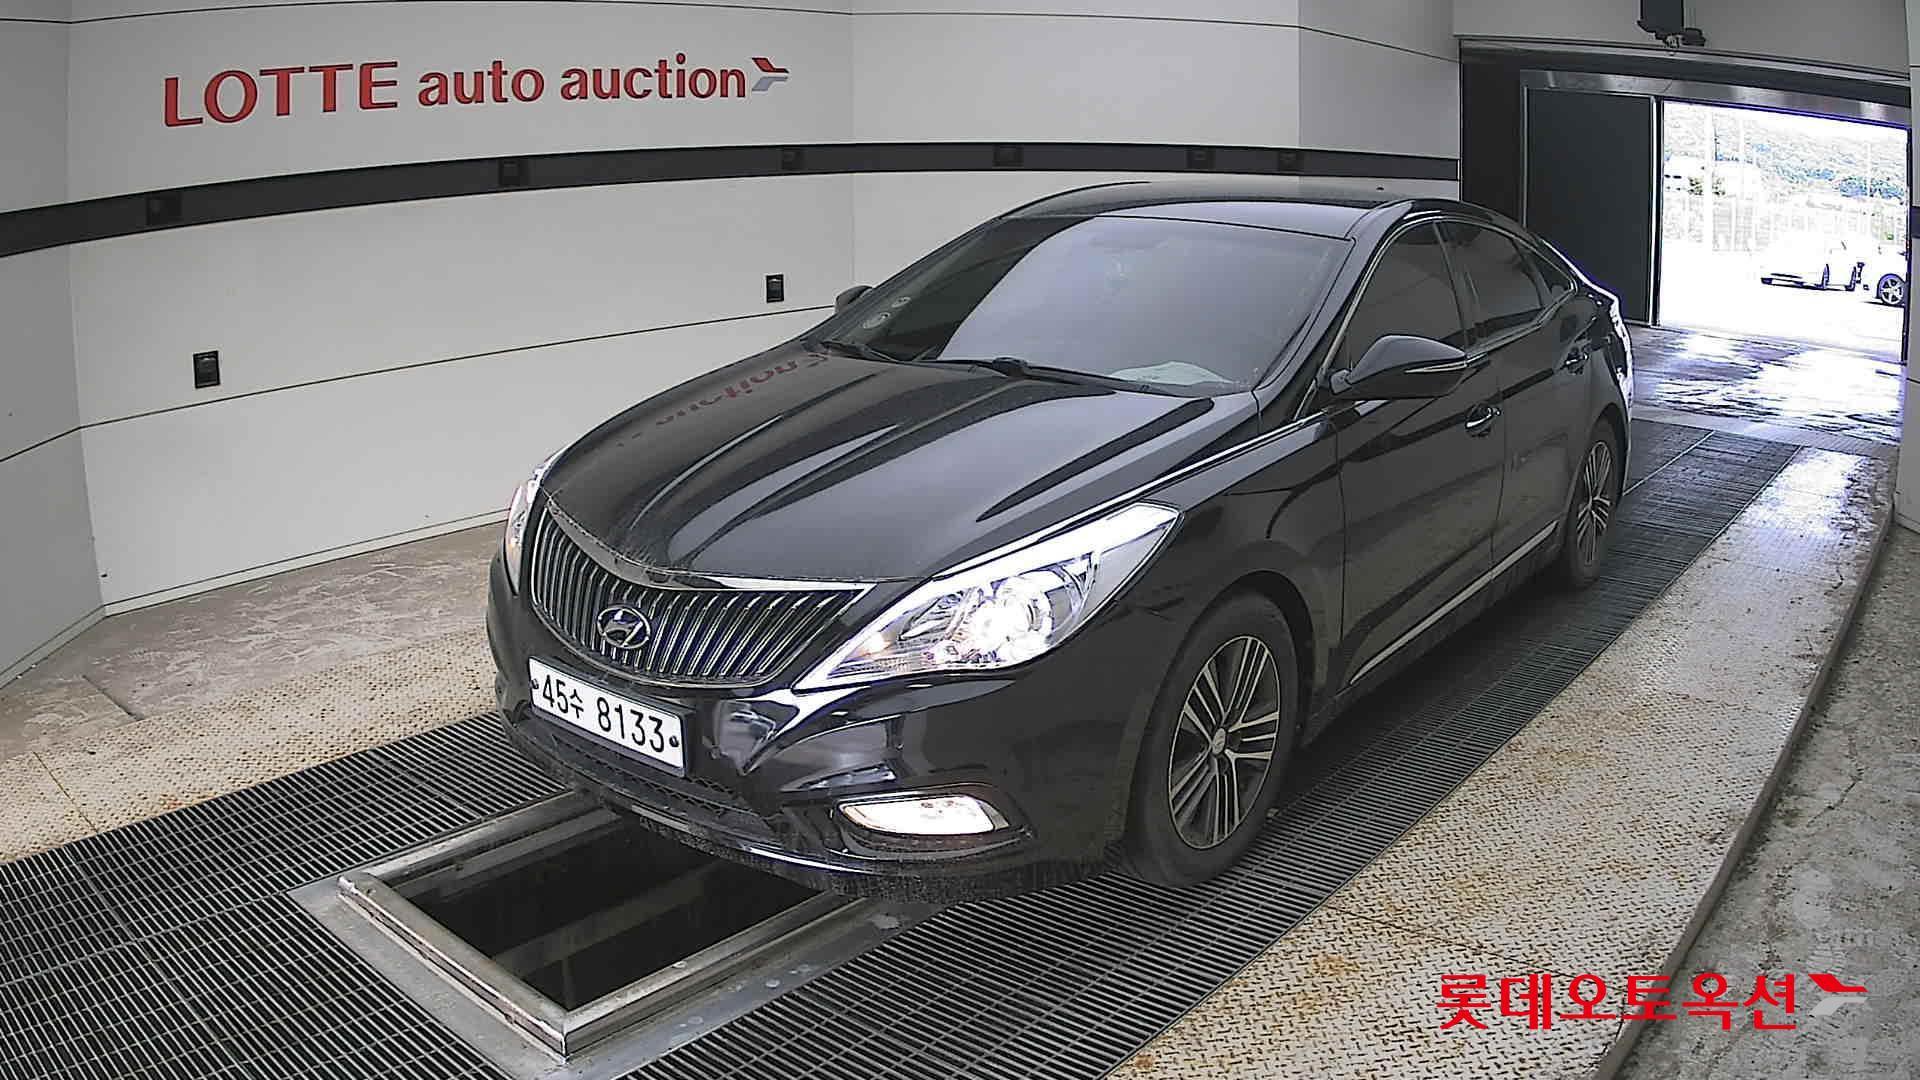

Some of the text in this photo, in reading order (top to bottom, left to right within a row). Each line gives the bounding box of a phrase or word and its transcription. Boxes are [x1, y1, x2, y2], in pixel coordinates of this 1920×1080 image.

[164, 52, 746, 127] LOTTE auto auction
[542, 674, 665, 753] 45수 8133
